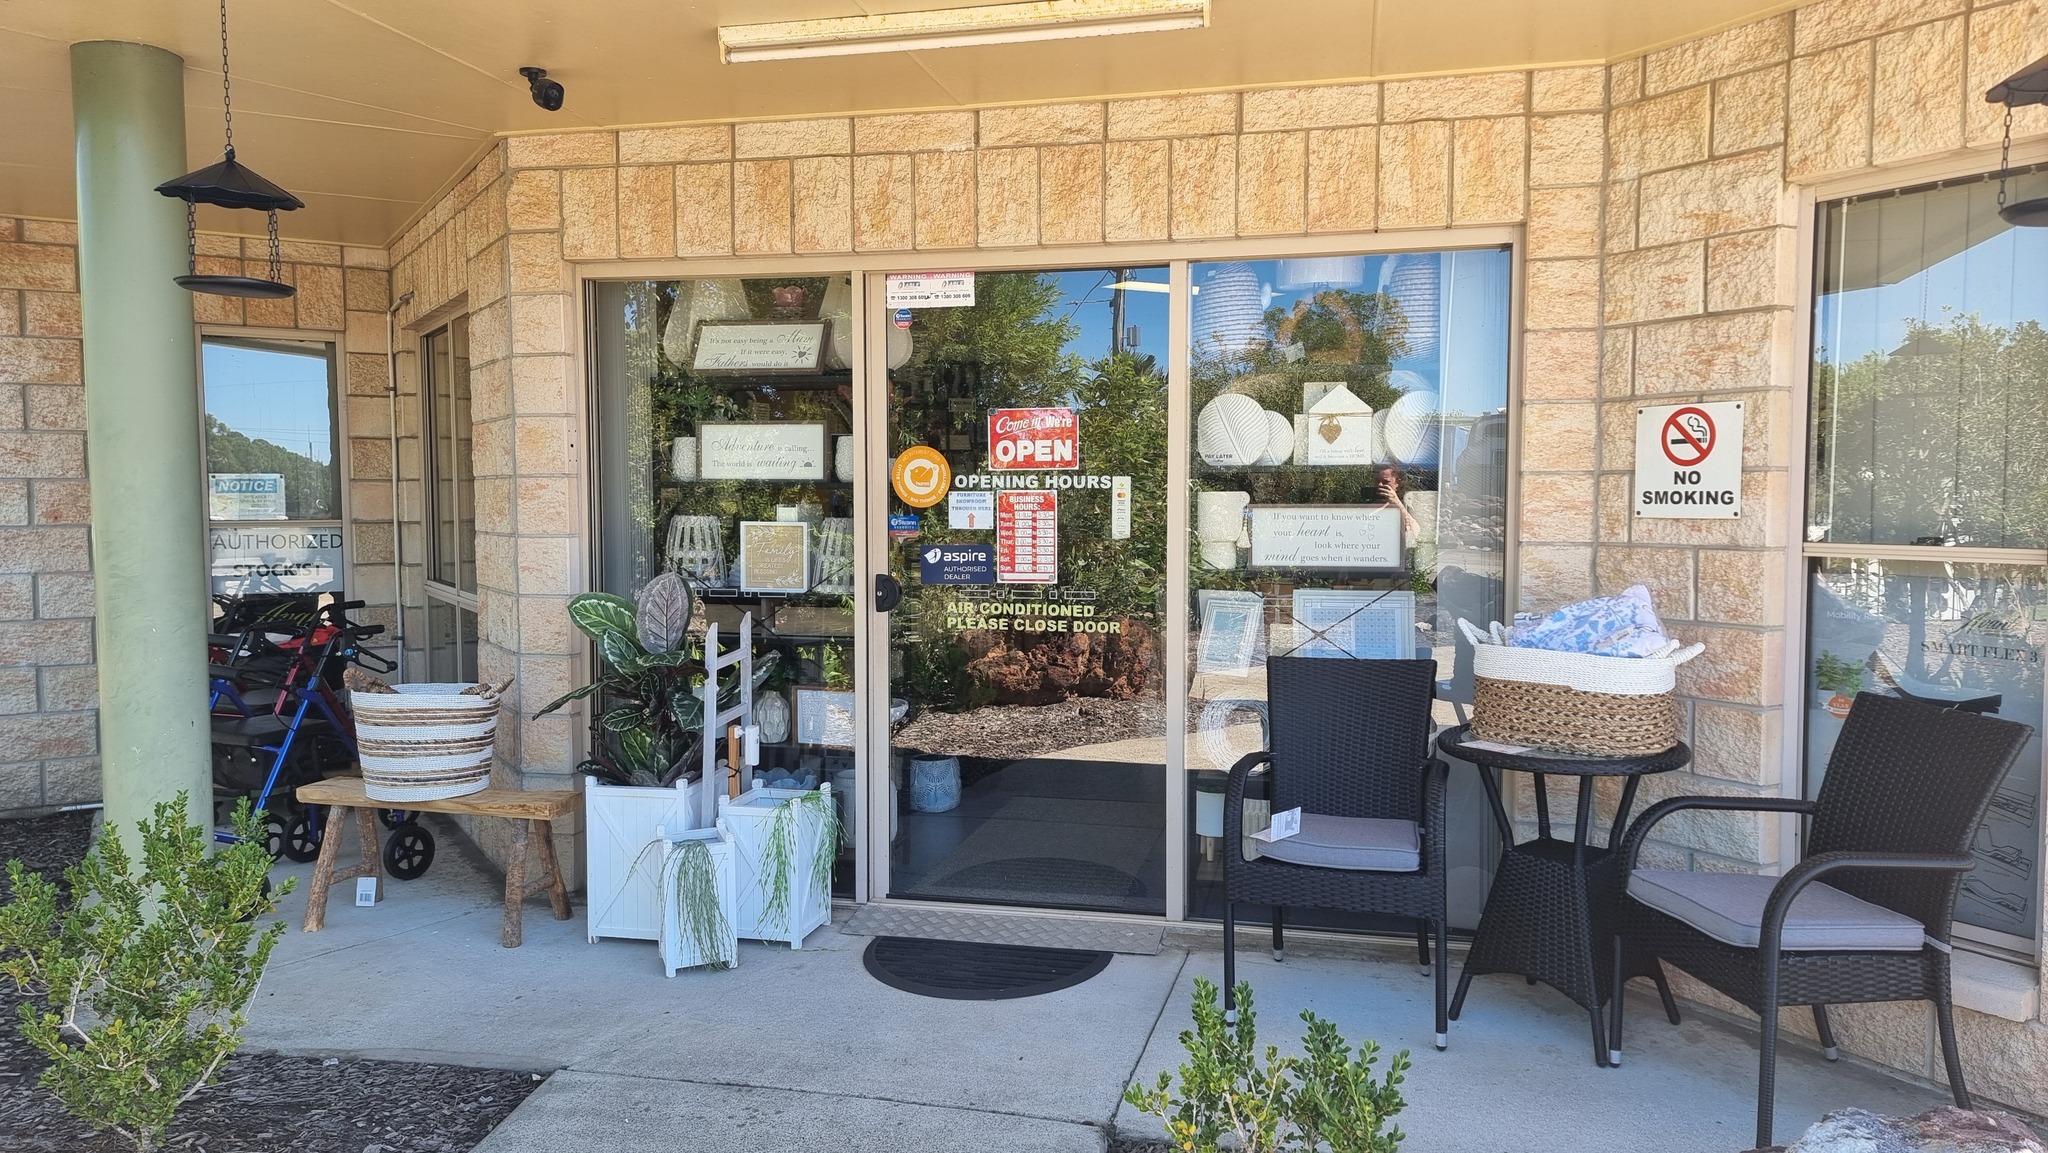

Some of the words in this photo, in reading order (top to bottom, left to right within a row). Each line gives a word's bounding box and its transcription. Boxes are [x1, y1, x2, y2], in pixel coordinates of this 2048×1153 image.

[749, 337, 767, 345] being
[777, 329, 814, 343] Mum
[703, 352, 748, 367] Fathers
[996, 416, 1029, 434] Come
[1045, 416, 1072, 428] We're
[711, 435, 774, 452] Adventure
[995, 439, 1072, 463] OPEN
[756, 455, 797, 474] waiting
[954, 474, 1039, 489] OPENING
[1045, 475, 1112, 489] HOURS
[1673, 470, 1701, 485] NO
[217, 480, 274, 492] NOTICE
[1642, 490, 1734, 505] SMOKING
[1282, 514, 1297, 523] you
[1331, 513, 1353, 521] know
[1355, 513, 1381, 521] where
[1273, 530, 1292, 539] your
[1296, 522, 1331, 537] heart
[212, 534, 343, 550] AUTHORIZED
[1314, 541, 1332, 549] look
[1334, 541, 1360, 549] where
[1361, 543, 1381, 552] your
[755, 542, 799, 563] Family
[943, 549, 987, 564] aspire
[1264, 547, 1300, 562] mind
[1300, 555, 1319, 563] goes
[1321, 554, 1343, 562] when
[1345, 554, 1351, 562] it
[1353, 554, 1389, 563] wanders.
[232, 563, 320, 577] STOCKIST
[946, 602, 975, 614] AIR
[979, 603, 1094, 617] CONDITIONED
[1826, 610, 1861, 621] Mobility
[946, 617, 1009, 631] PLEASE
[1013, 619, 1068, 632] CLOSE
[1073, 621, 1121, 633] DOOR
[1921, 641, 1978, 657] SMART
[2030, 651, 2038, 663] 3
